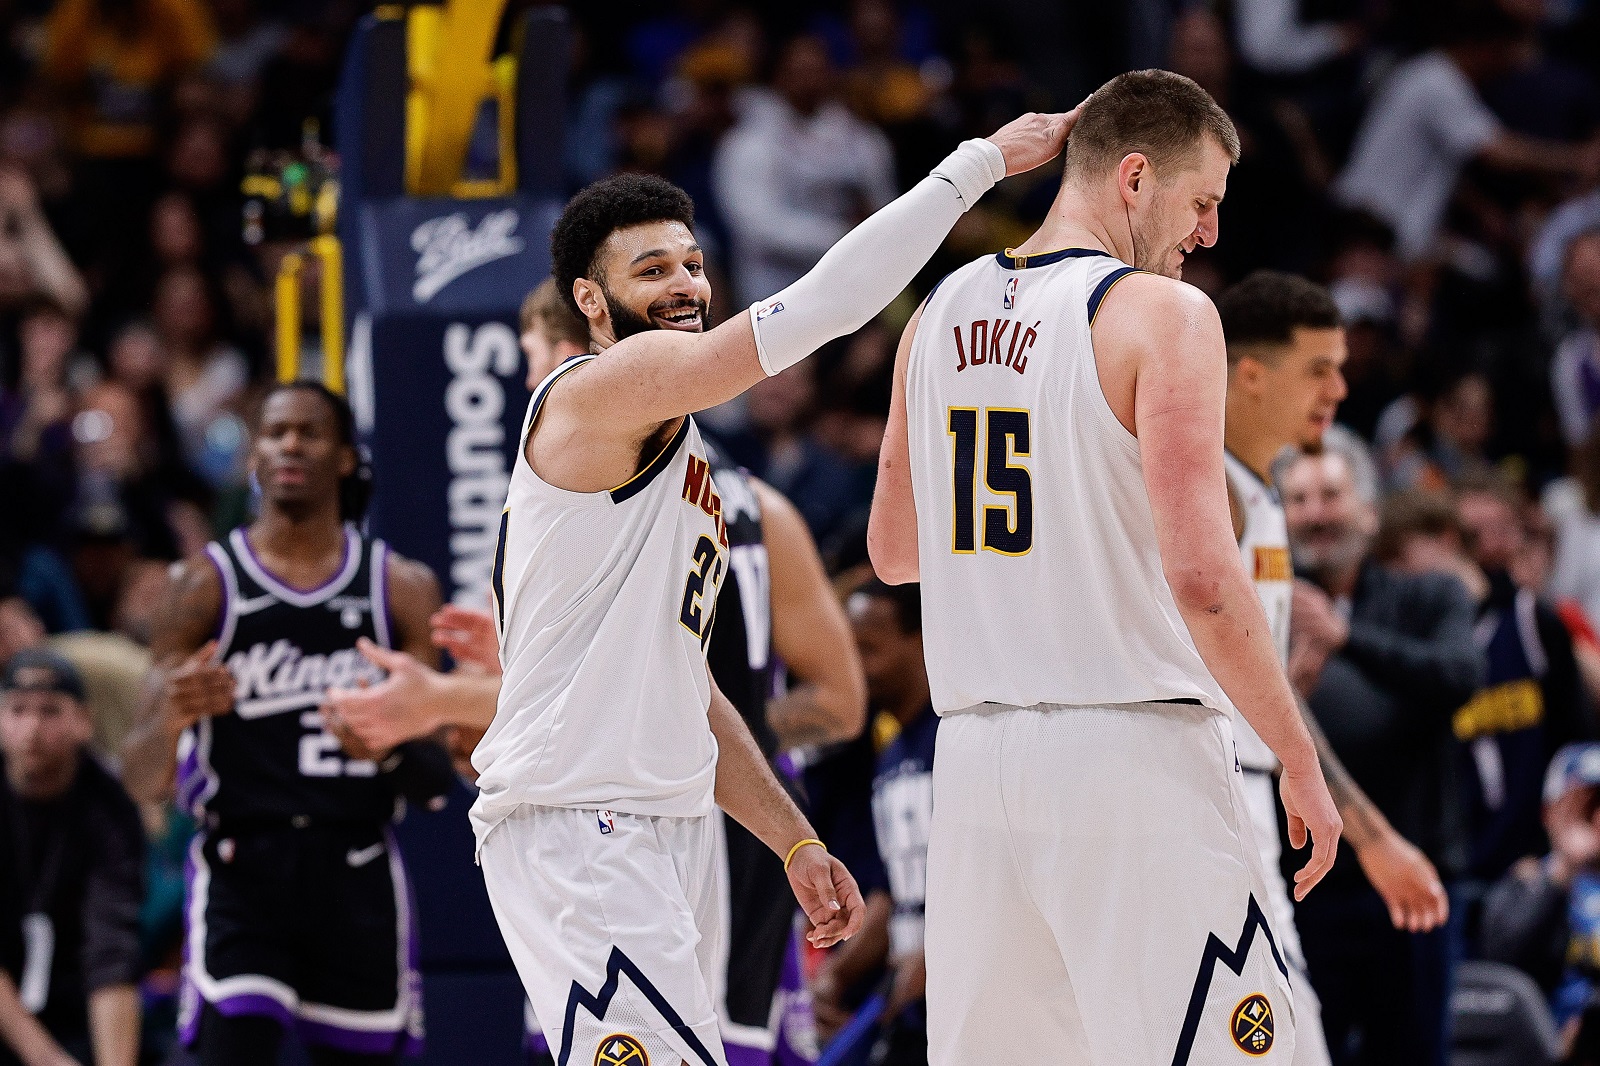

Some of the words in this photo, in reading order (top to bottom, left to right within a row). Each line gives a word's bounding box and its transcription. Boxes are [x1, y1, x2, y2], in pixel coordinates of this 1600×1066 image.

[953, 318, 1041, 374] JOKIĆ
[947, 406, 1034, 557] 15
[299, 711, 378, 777] 2
